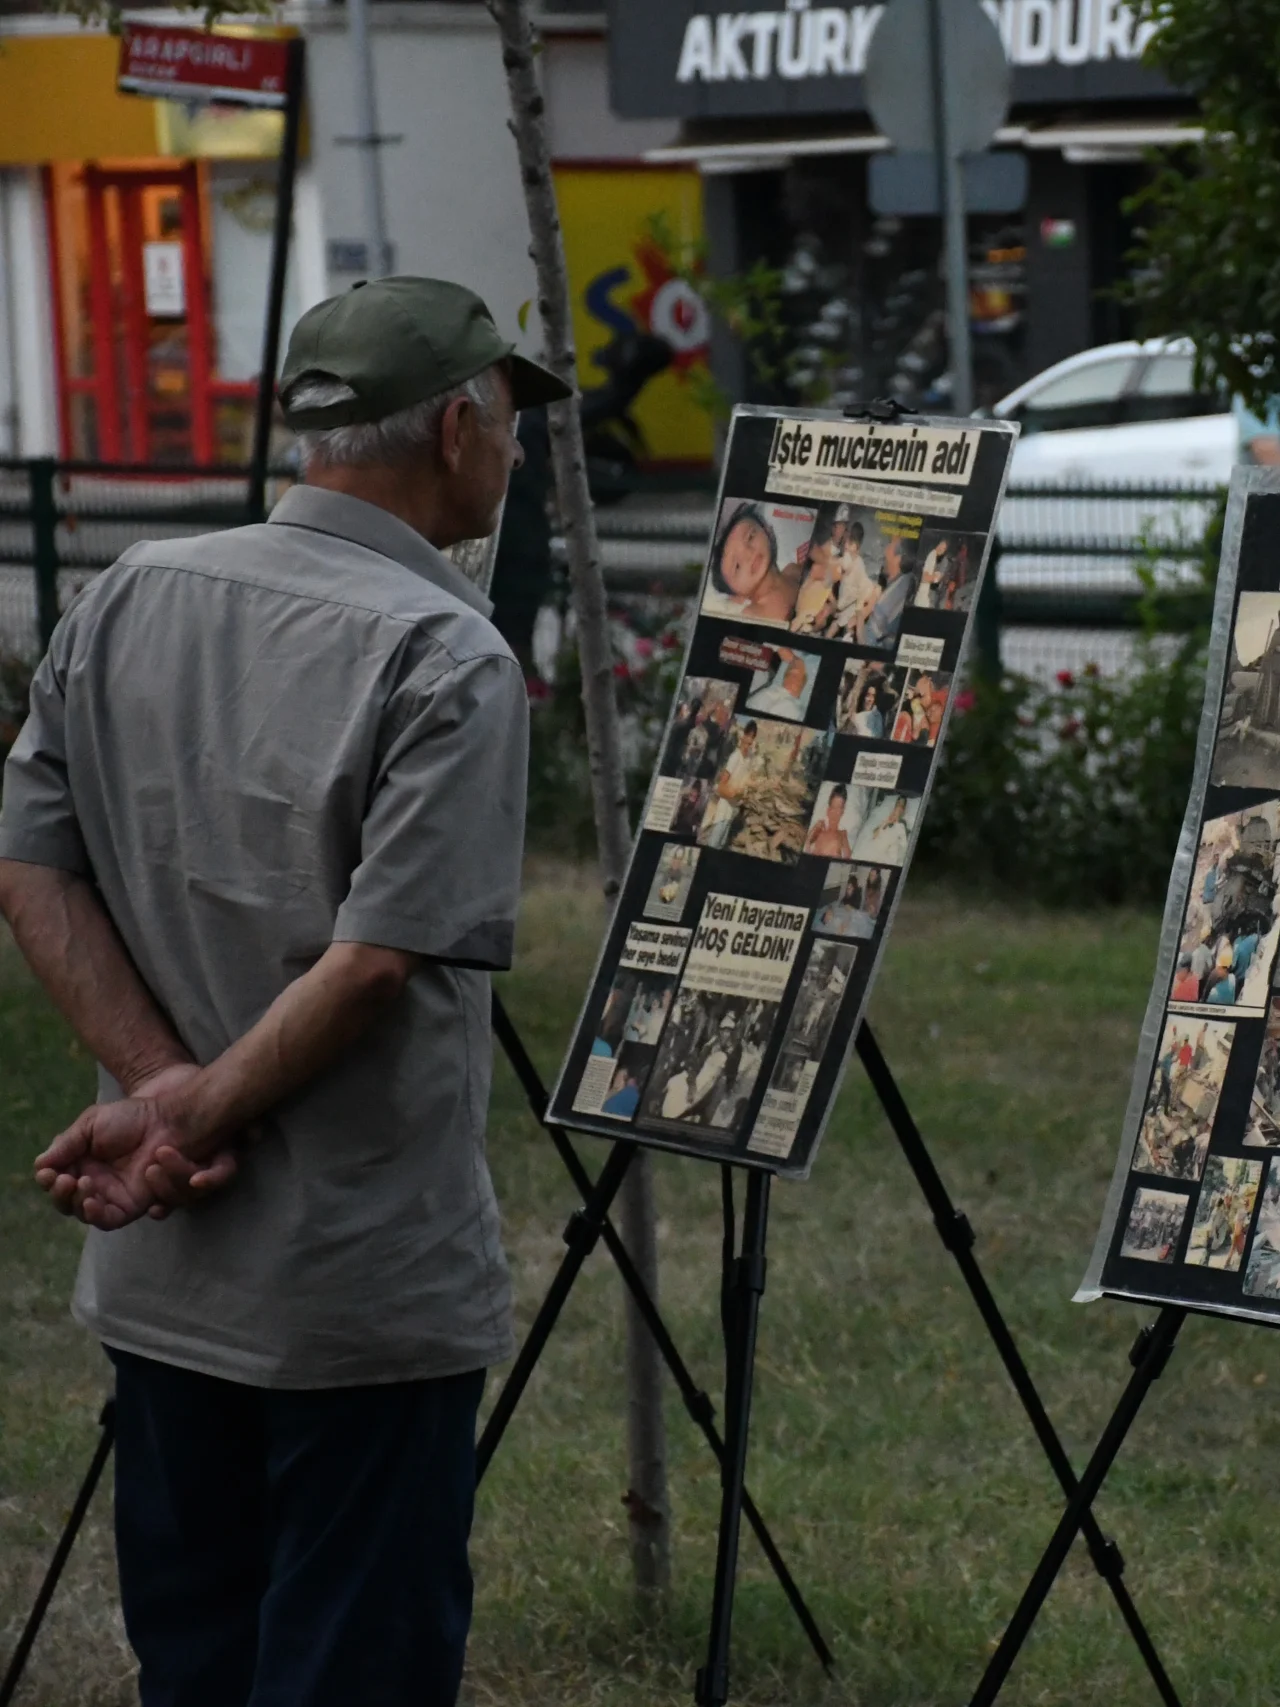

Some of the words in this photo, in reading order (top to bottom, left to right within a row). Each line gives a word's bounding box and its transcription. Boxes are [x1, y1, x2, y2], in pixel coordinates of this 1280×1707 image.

[815, 426, 929, 473] mucizenin
[930, 431, 971, 475] adı
[705, 895, 739, 922] Yeni
[737, 900, 805, 932] hayatına
[693, 925, 730, 958] HOŞ
[730, 931, 795, 962] GELDİN!
